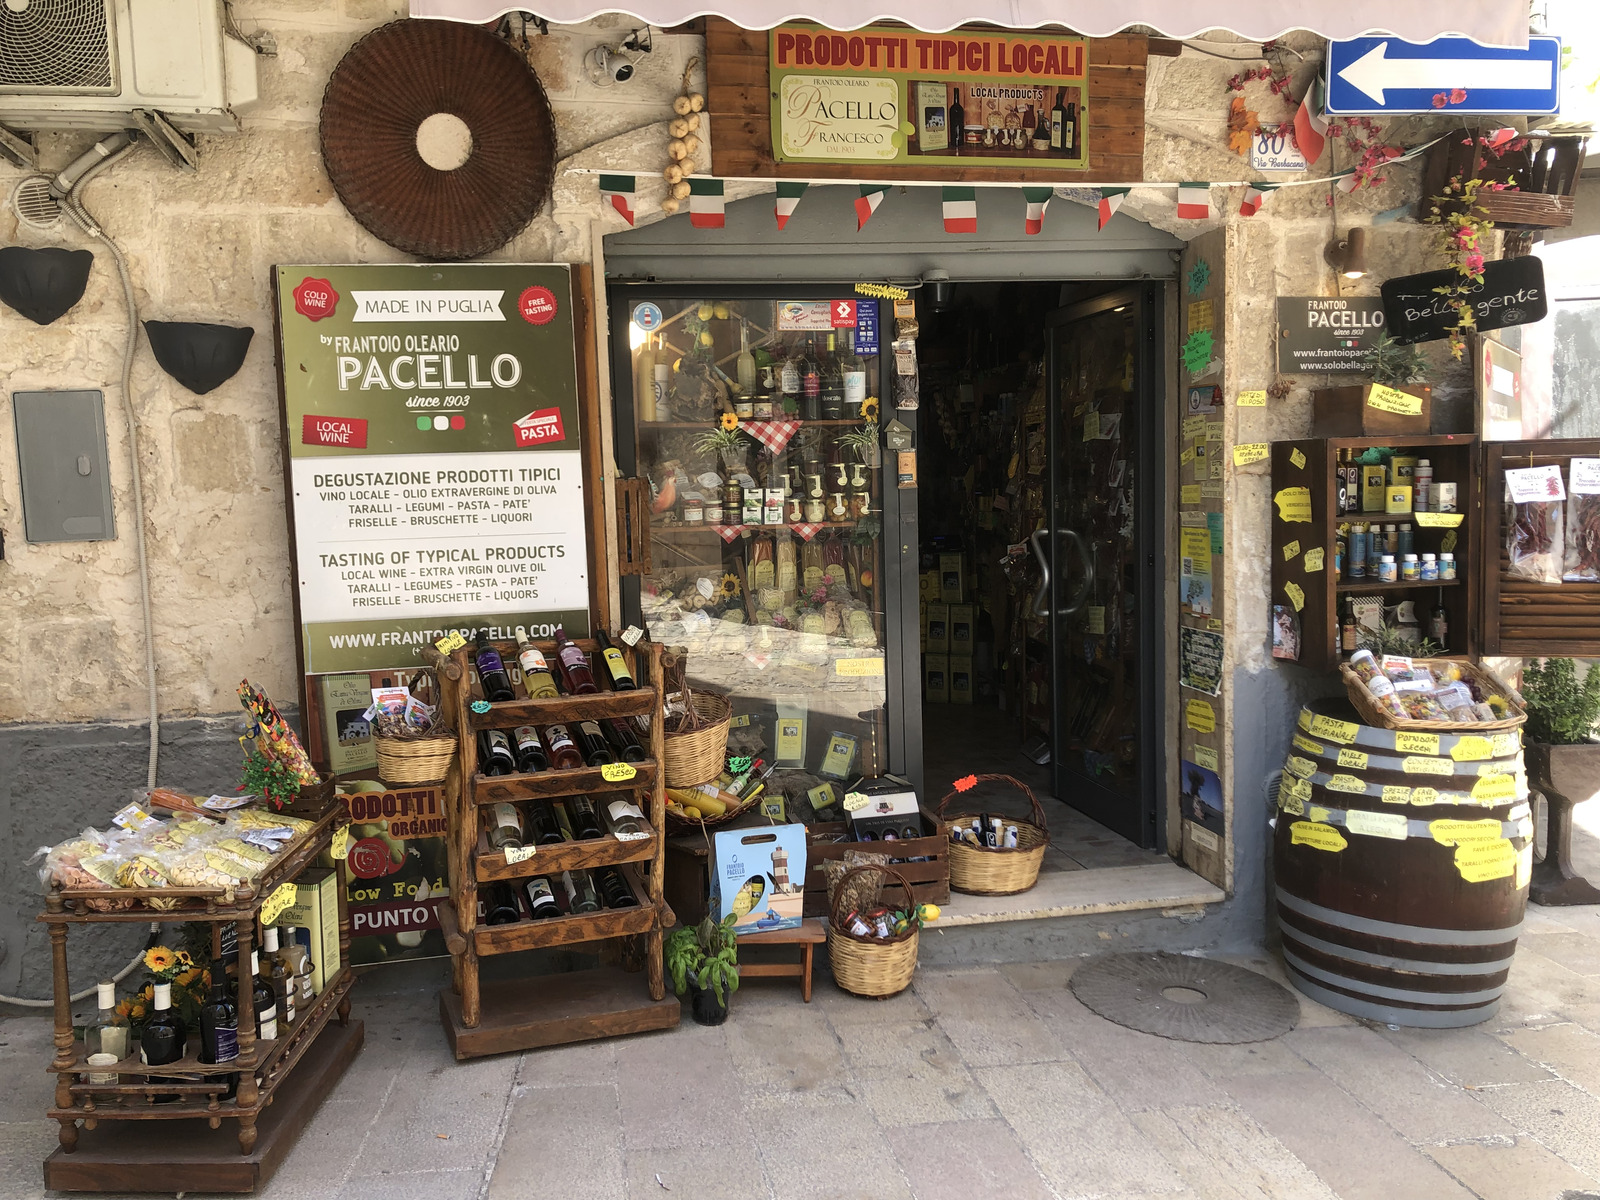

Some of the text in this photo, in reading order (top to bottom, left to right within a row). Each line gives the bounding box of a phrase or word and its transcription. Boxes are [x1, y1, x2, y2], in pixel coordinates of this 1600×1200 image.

[778, 33, 1084, 77] PRODOTTI TIPICI LOCALI
[813, 79, 843, 87] FRANTOIO
[971, 87, 1043, 100] LOCAL PRODUCTS
[787, 85, 896, 120] PACELLO
[794, 119, 884, 147] FRANCESCO
[841, 146, 856, 154] 1903
[304, 290, 328, 300] COLD
[304, 298, 326, 309] WINE
[365, 299, 493, 314] MADE IN PUGLIA
[528, 298, 546, 307] FREE
[1308, 300, 1347, 310] FRANTOIO
[1477, 288, 1538, 317] gente
[524, 303, 553, 316] TASTING
[1308, 310, 1384, 328] PACELLO
[320, 334, 459, 353] by FRANTOIO OLEARIO
[337, 353, 522, 391] PACELLO
[406, 395, 470, 408] since 1903
[316, 421, 353, 434] LOCAL
[521, 424, 560, 441] PASTA
[319, 431, 350, 444] WINE
[314, 468, 561, 488] DEGUSTAZIONE PRODOTTI TIPICI
[320, 485, 557, 501] VINO LOCALE OLIO EXTRAVERGINE DI OLIVA
[348, 500, 531, 515] TARALLI LEGUMI PASTA PATE'
[348, 513, 533, 528] FRISELLE BRUSCHETTE LIQUORI
[319, 545, 565, 568] TASTING OF TYPICAL PRODUCTS
[341, 562, 547, 581] LOCAL WINE EXTRA VIRGIN OLIVE OIL
[348, 577, 539, 594] TARALLI LEGUMES PASTA PATE'
[352, 589, 539, 607] FRISELLE BRUSCHETTE LIQUORS
[1321, 717, 1345, 729] PASTA
[1397, 734, 1438, 744] POMODORI
[1341, 752, 1364, 760] MIELE
[1339, 759, 1367, 768] LOCALE
[605, 769, 635, 778] FRESCO
[1334, 775, 1356, 783] PASTA
[1383, 787, 1410, 795] SPEZIE
[1416, 788, 1433, 796] FAVE
[1412, 794, 1437, 803] FRITTE
[340, 790, 436, 821] RODOTTI
[727, 862, 745, 870] FRANTOIO
[727, 868, 745, 876] PACELLO
[353, 905, 429, 930] PUNTO
